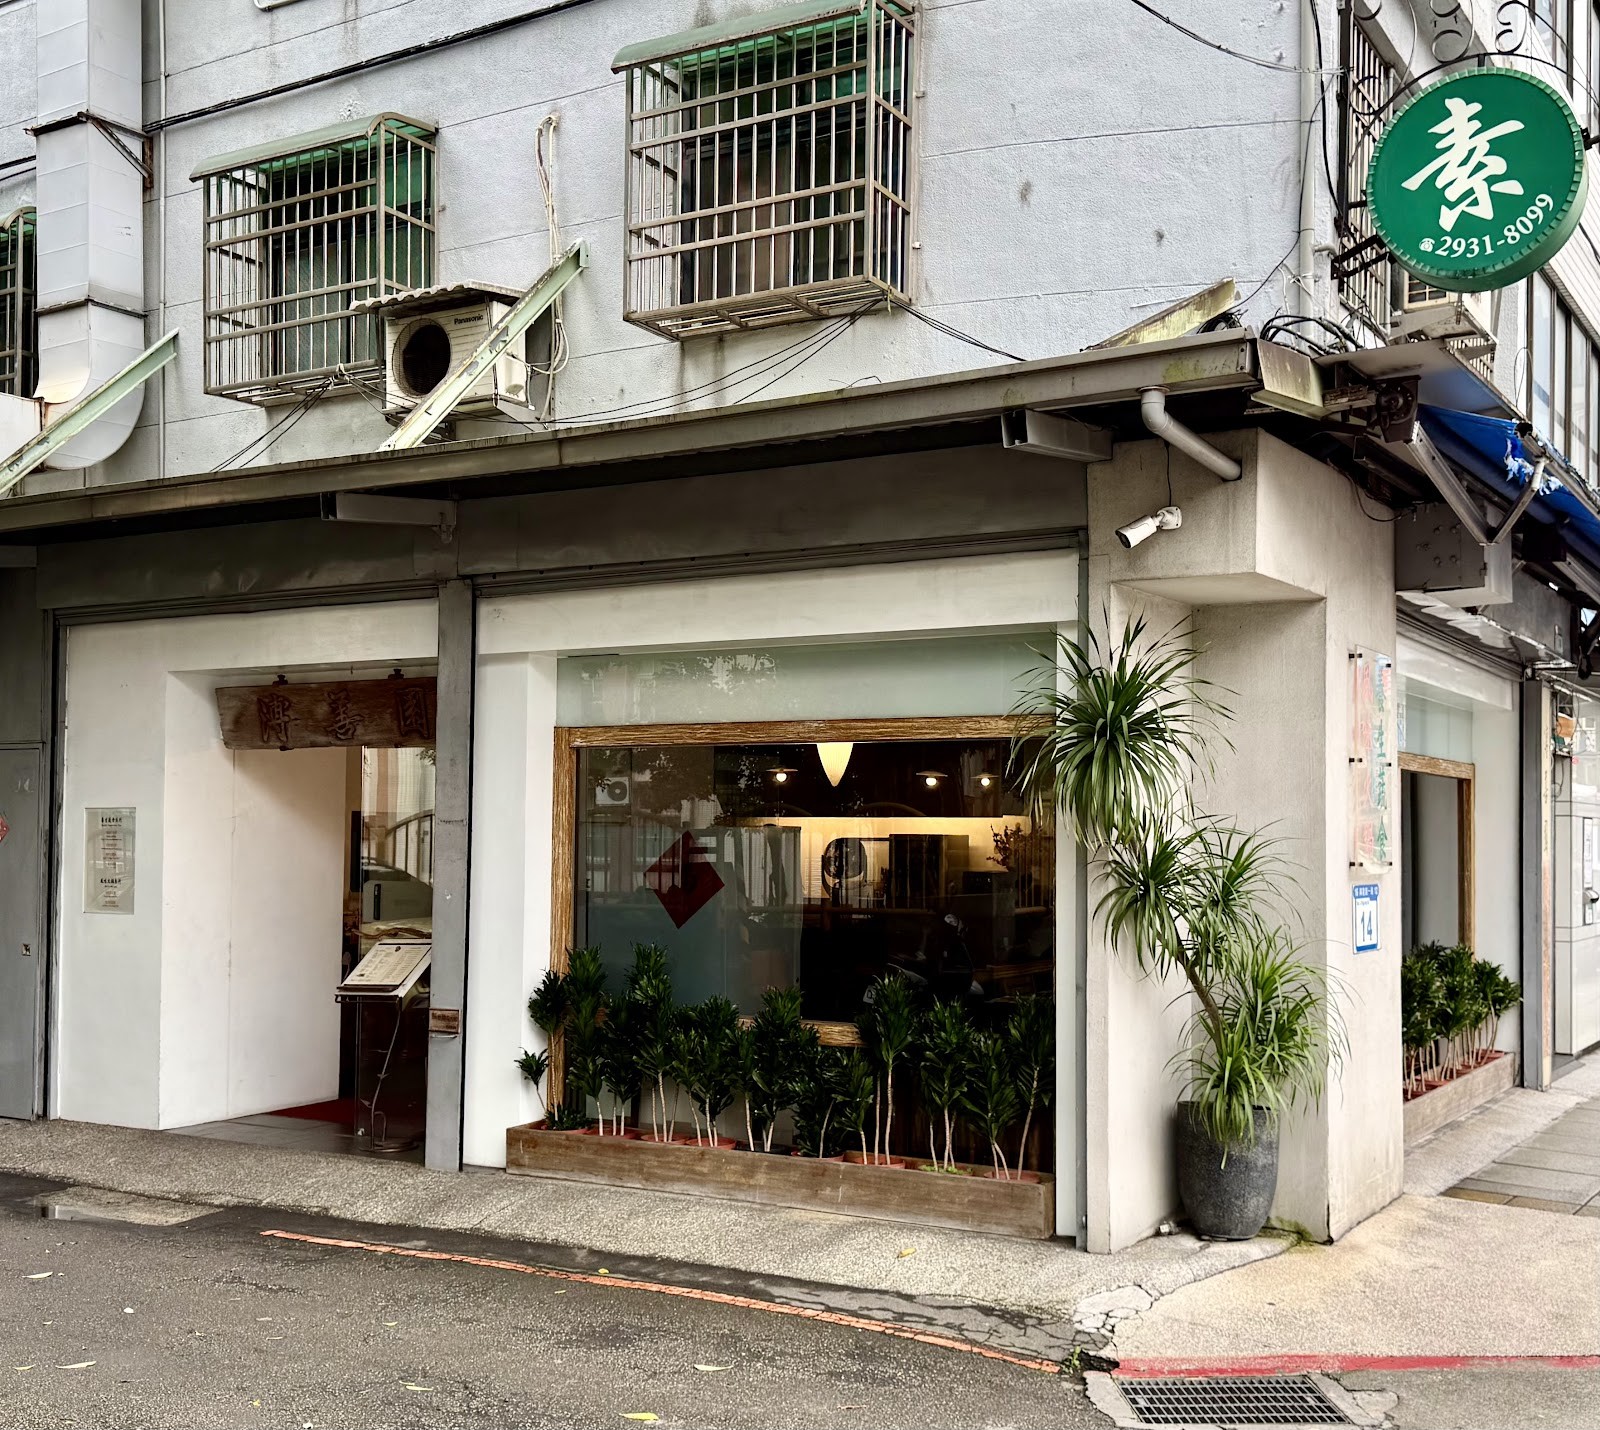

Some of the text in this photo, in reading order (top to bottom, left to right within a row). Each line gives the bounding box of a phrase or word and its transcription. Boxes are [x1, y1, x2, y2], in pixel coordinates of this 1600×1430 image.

[1401, 97, 1525, 232] 素
[1435, 193, 1554, 258] 2931-8099
[454, 313, 484, 325] Panasonic
[1360, 910, 1373, 943] 14
